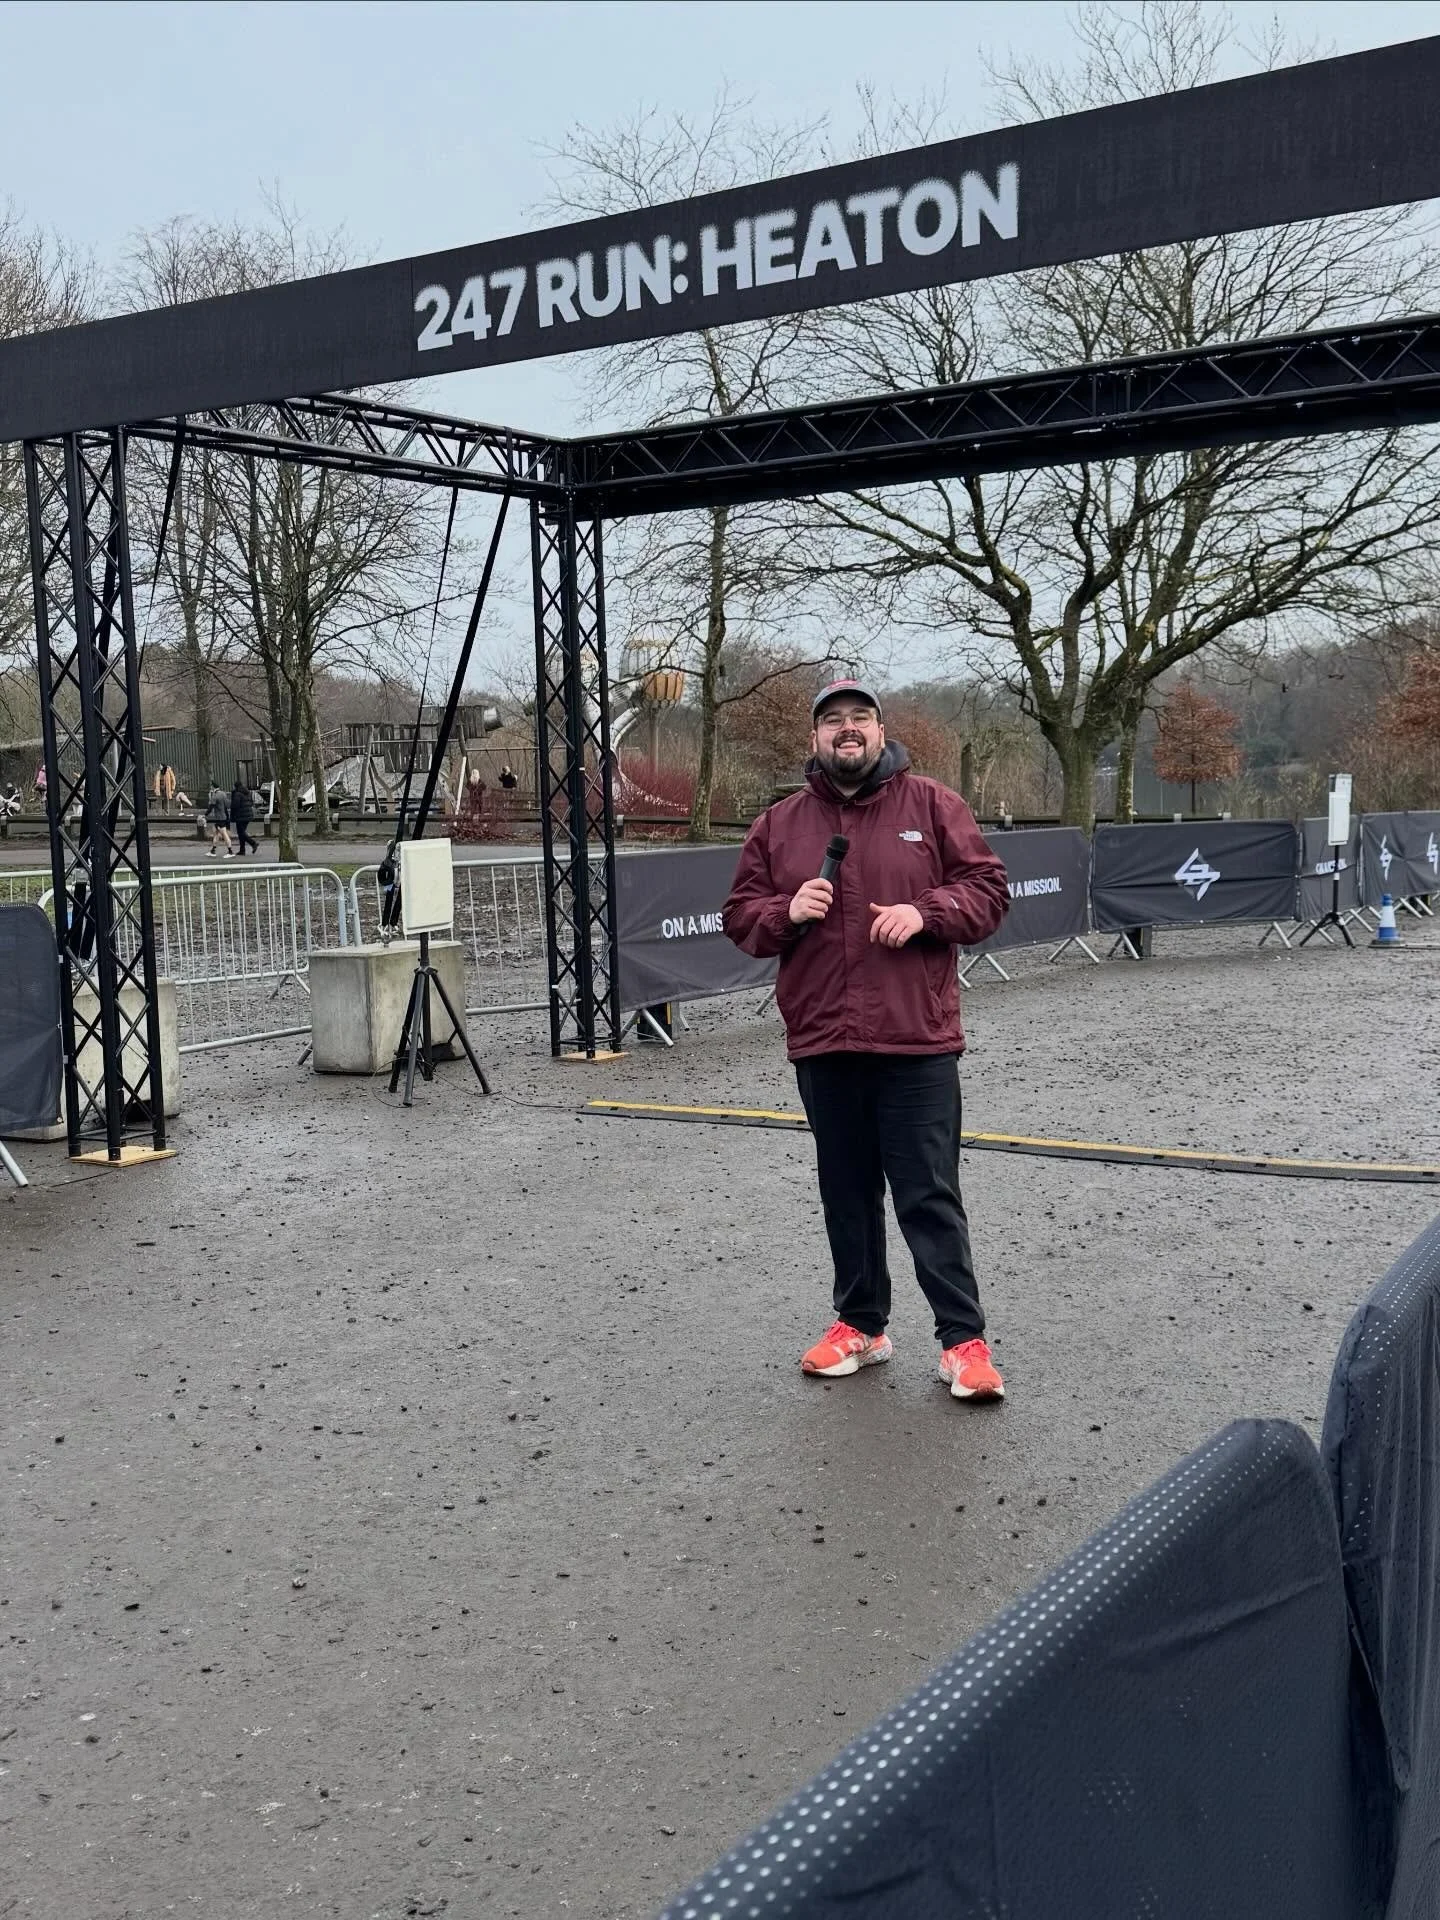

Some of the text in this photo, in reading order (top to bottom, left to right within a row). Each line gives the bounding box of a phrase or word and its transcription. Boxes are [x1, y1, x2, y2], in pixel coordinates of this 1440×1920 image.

[414, 162, 1019, 352] 247 RUN: HEATON
[1007, 876, 1062, 898] N A MISSION.
[662, 917, 684, 938] ON
[688, 915, 698, 935] A
